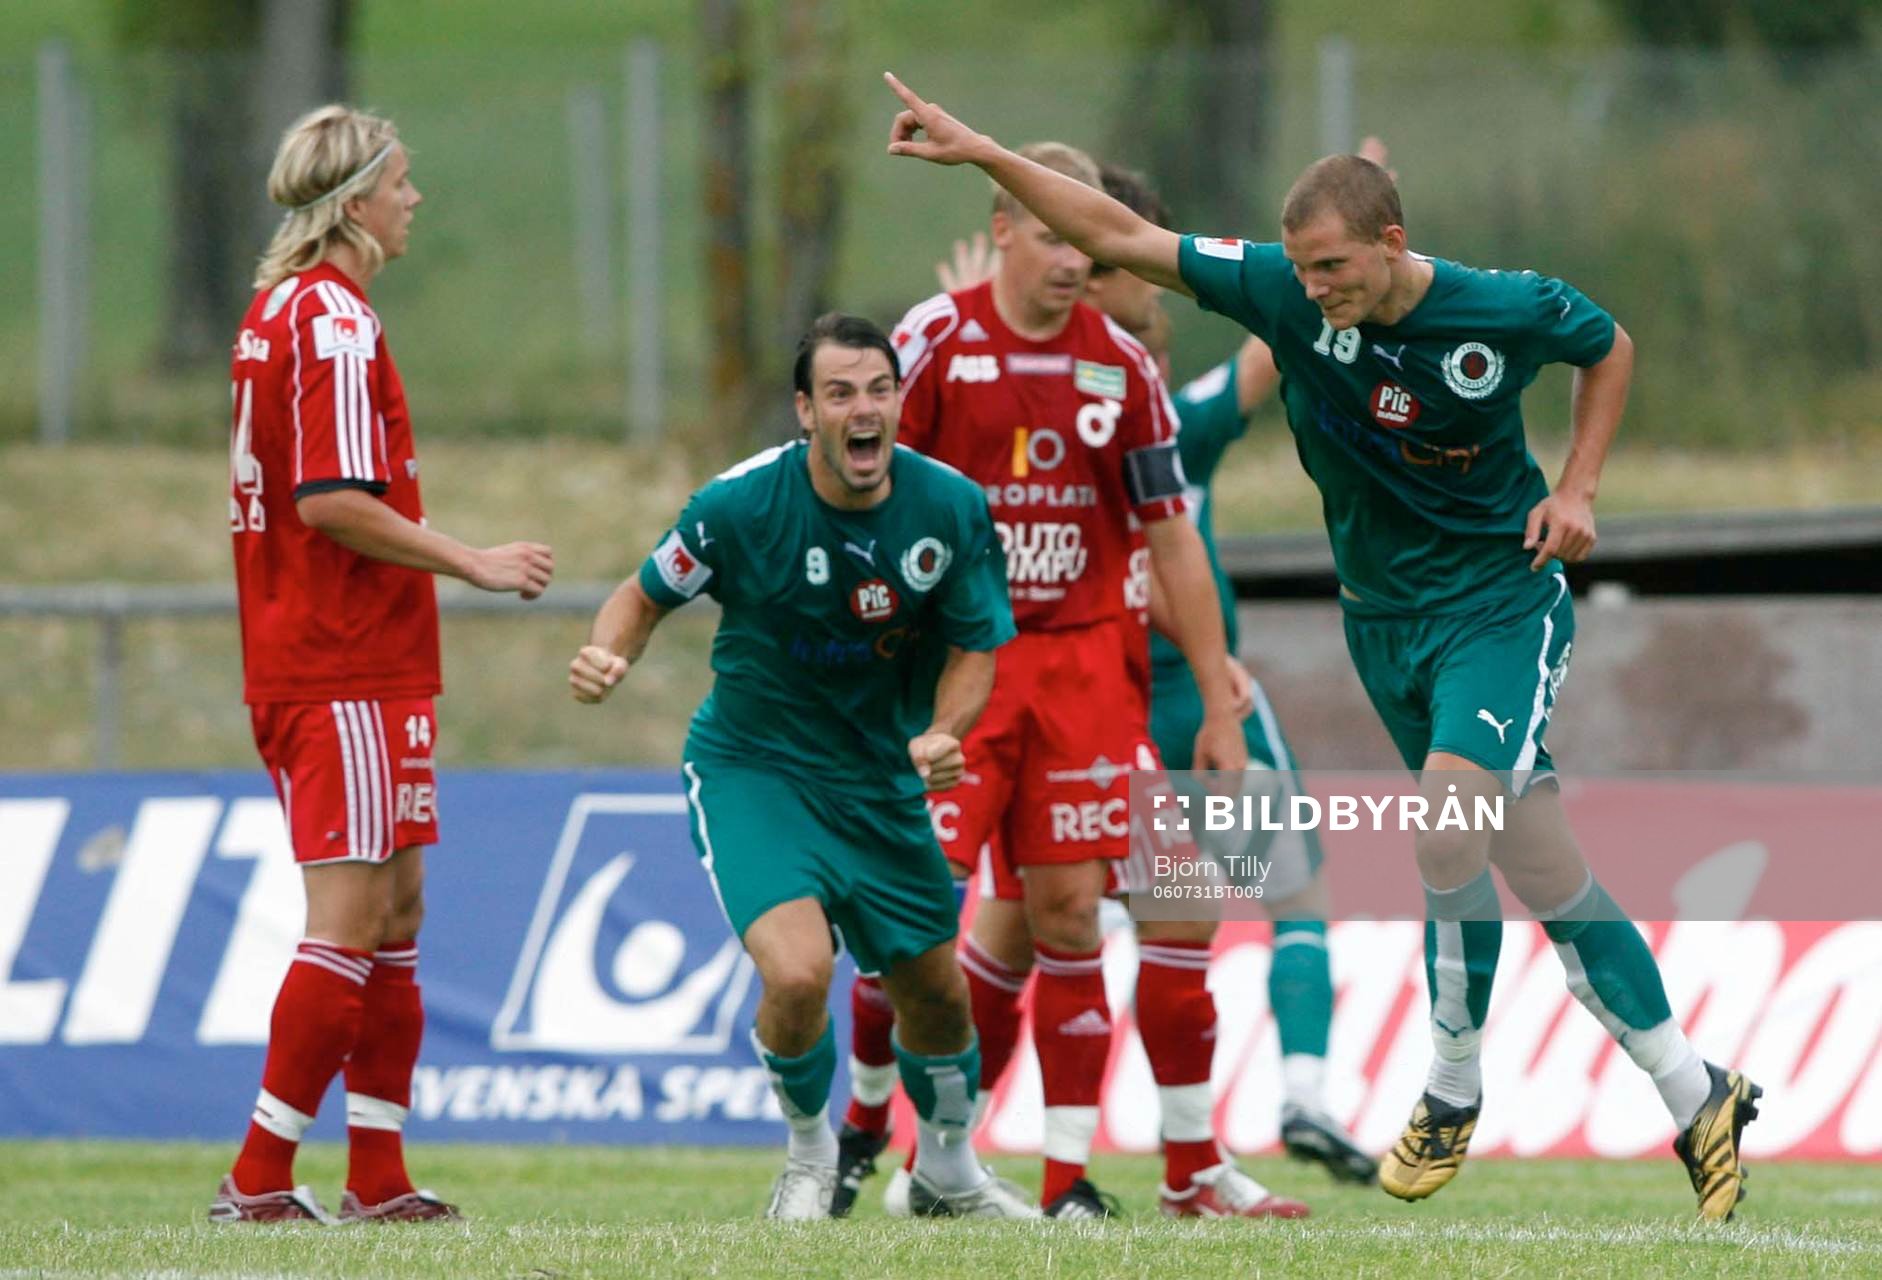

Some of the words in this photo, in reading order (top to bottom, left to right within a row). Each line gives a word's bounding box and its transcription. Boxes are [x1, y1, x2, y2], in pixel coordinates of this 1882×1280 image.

[1313, 317, 1361, 364] 19
[946, 354, 1000, 383] ABB
[806, 546, 830, 585] 9
[404, 715, 431, 749] 14
[1051, 798, 1130, 842] REC
[411, 1065, 643, 1121] VENSKA
